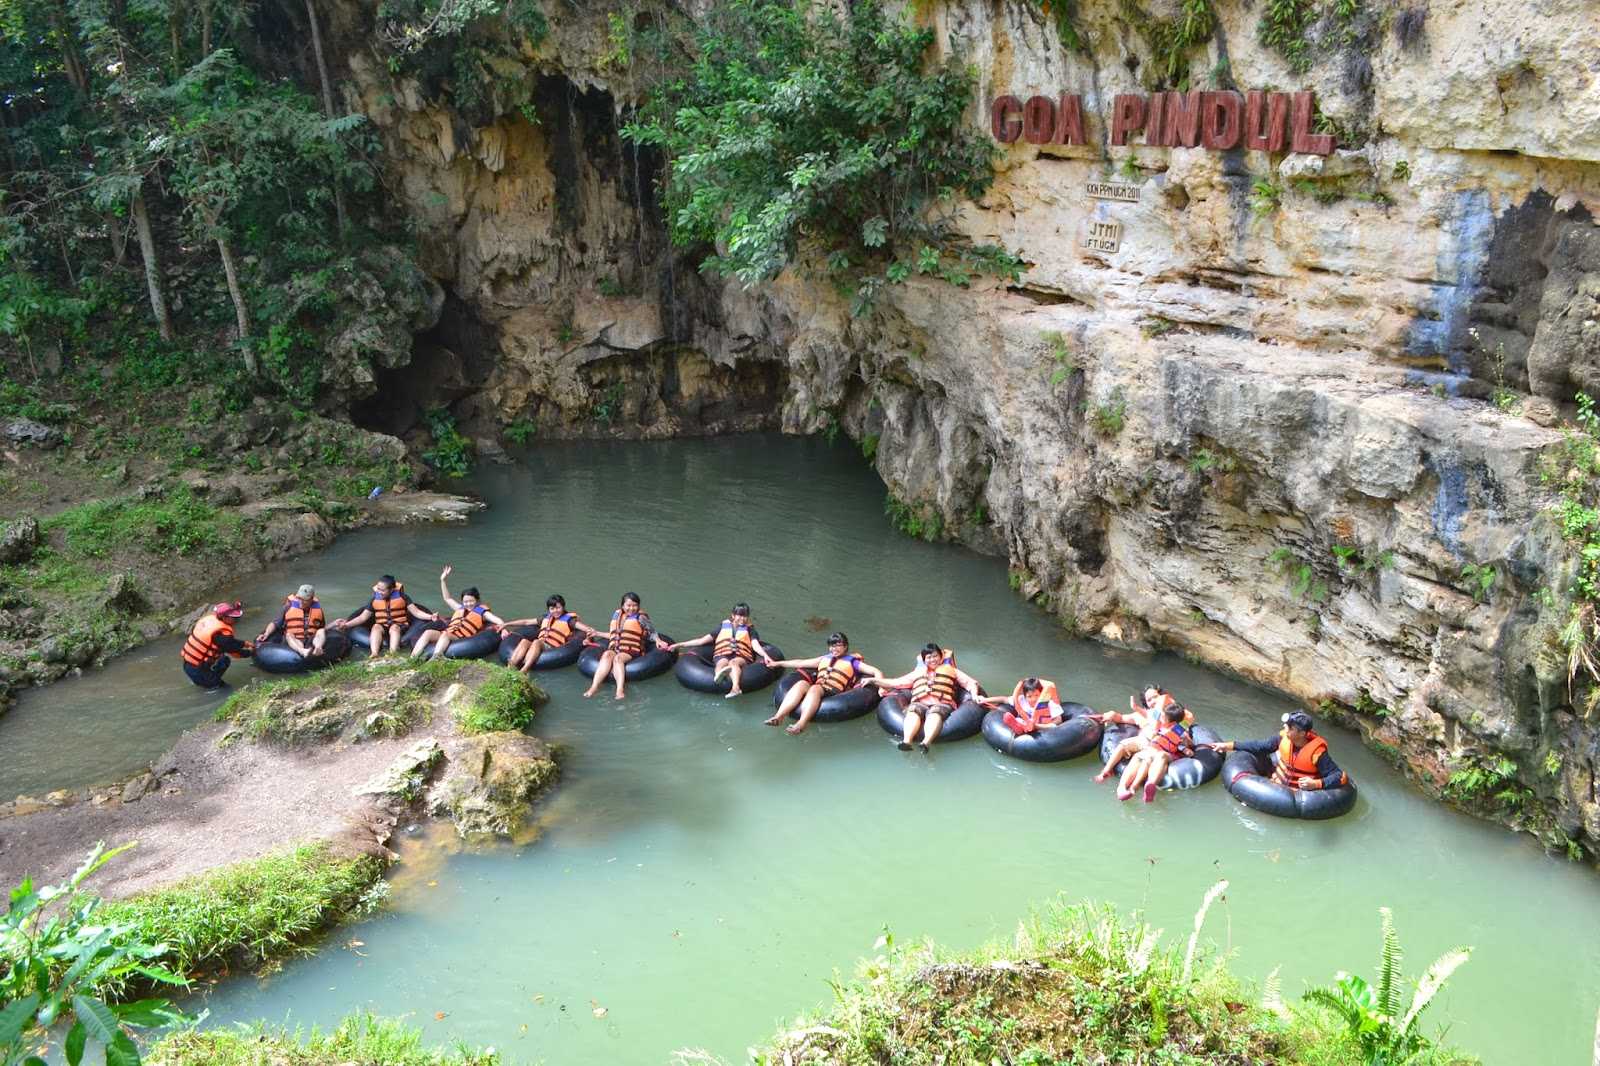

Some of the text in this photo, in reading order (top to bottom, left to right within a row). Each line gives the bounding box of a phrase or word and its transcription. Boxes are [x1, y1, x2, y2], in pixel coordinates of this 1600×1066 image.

[991, 89, 1337, 156] GOA PINDUL
[1100, 184, 1113, 197] PPM
[1113, 186, 1126, 198] UGM
[1089, 222, 1117, 239] JTMI
[1099, 240, 1115, 251] UGM
